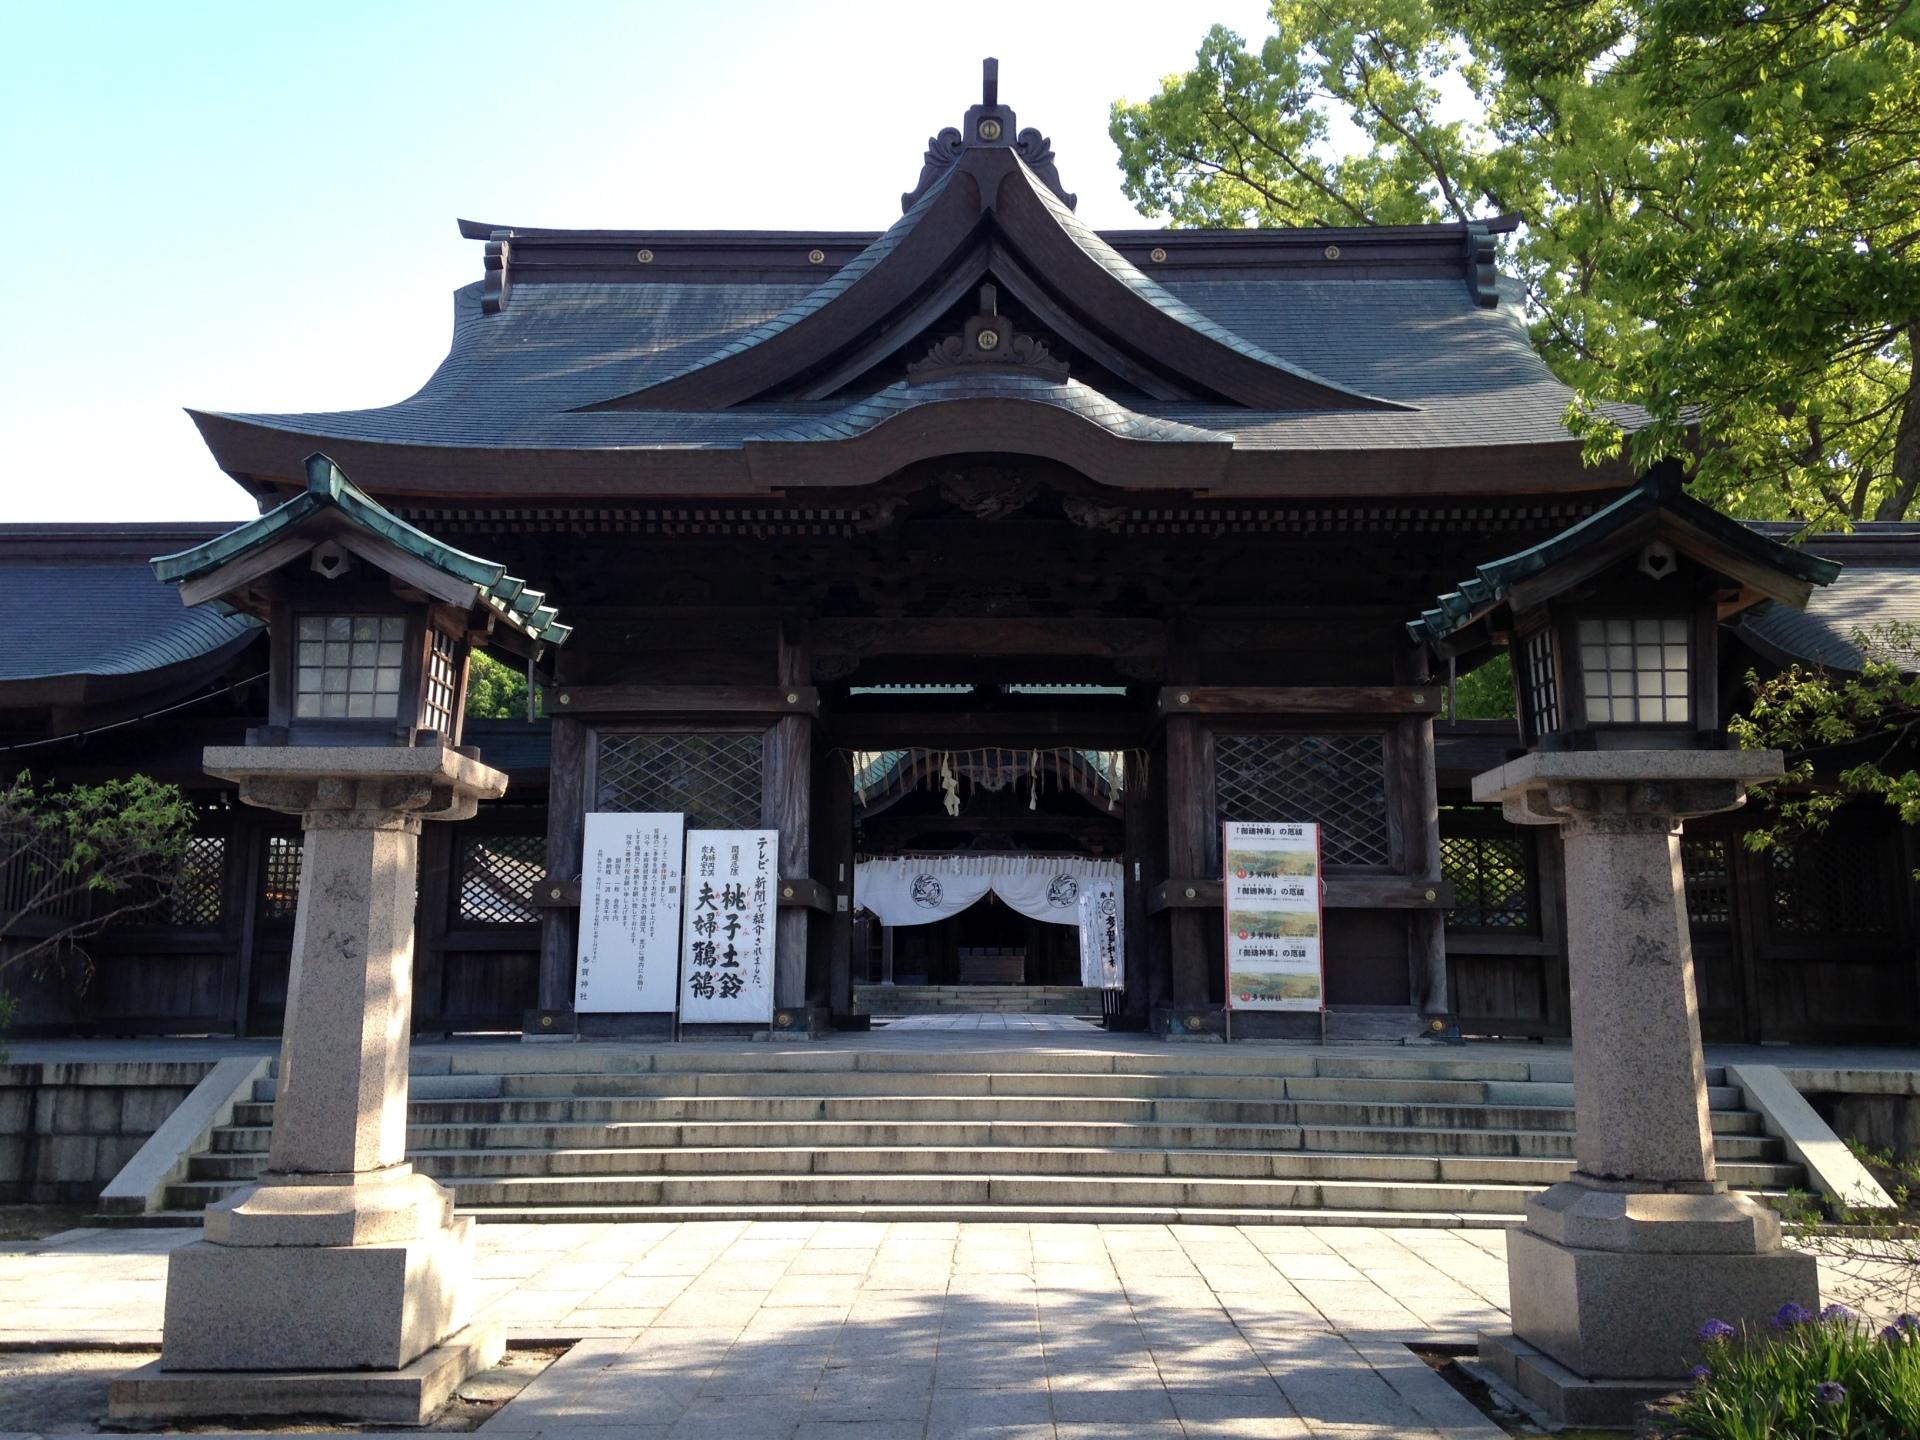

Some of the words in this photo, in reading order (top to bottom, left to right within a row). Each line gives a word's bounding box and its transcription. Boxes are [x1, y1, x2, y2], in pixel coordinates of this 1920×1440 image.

[1248, 871, 1279, 879] 多賀神社
[668, 870, 678, 911] お願い
[717, 882, 747, 1000] 桃子土鈴
[1250, 931, 1281, 940] 多賀神社
[579, 956, 590, 1001] 多賀神社
[1251, 993, 1283, 1002] 多賀神社
